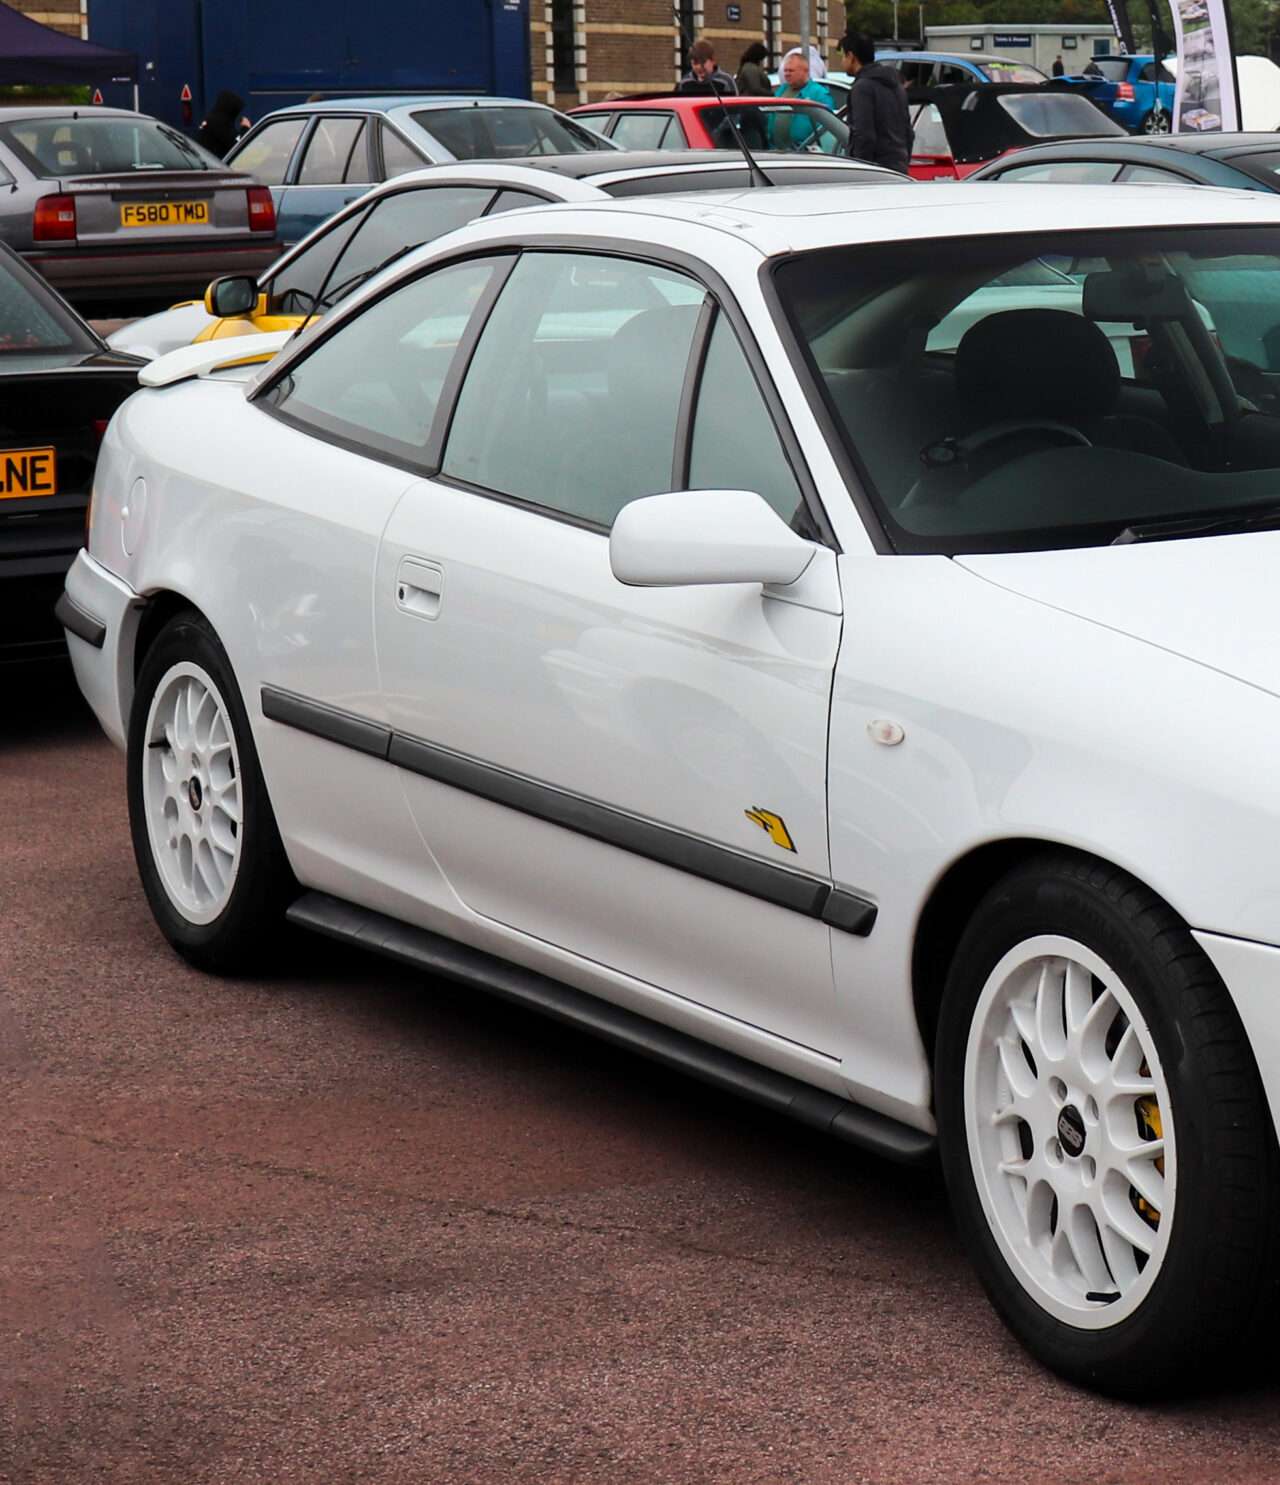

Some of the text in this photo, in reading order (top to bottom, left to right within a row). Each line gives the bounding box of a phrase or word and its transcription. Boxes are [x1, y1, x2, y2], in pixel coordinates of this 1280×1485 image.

[123, 202, 206, 223] F580 TMD
[0, 455, 52, 493] NE
